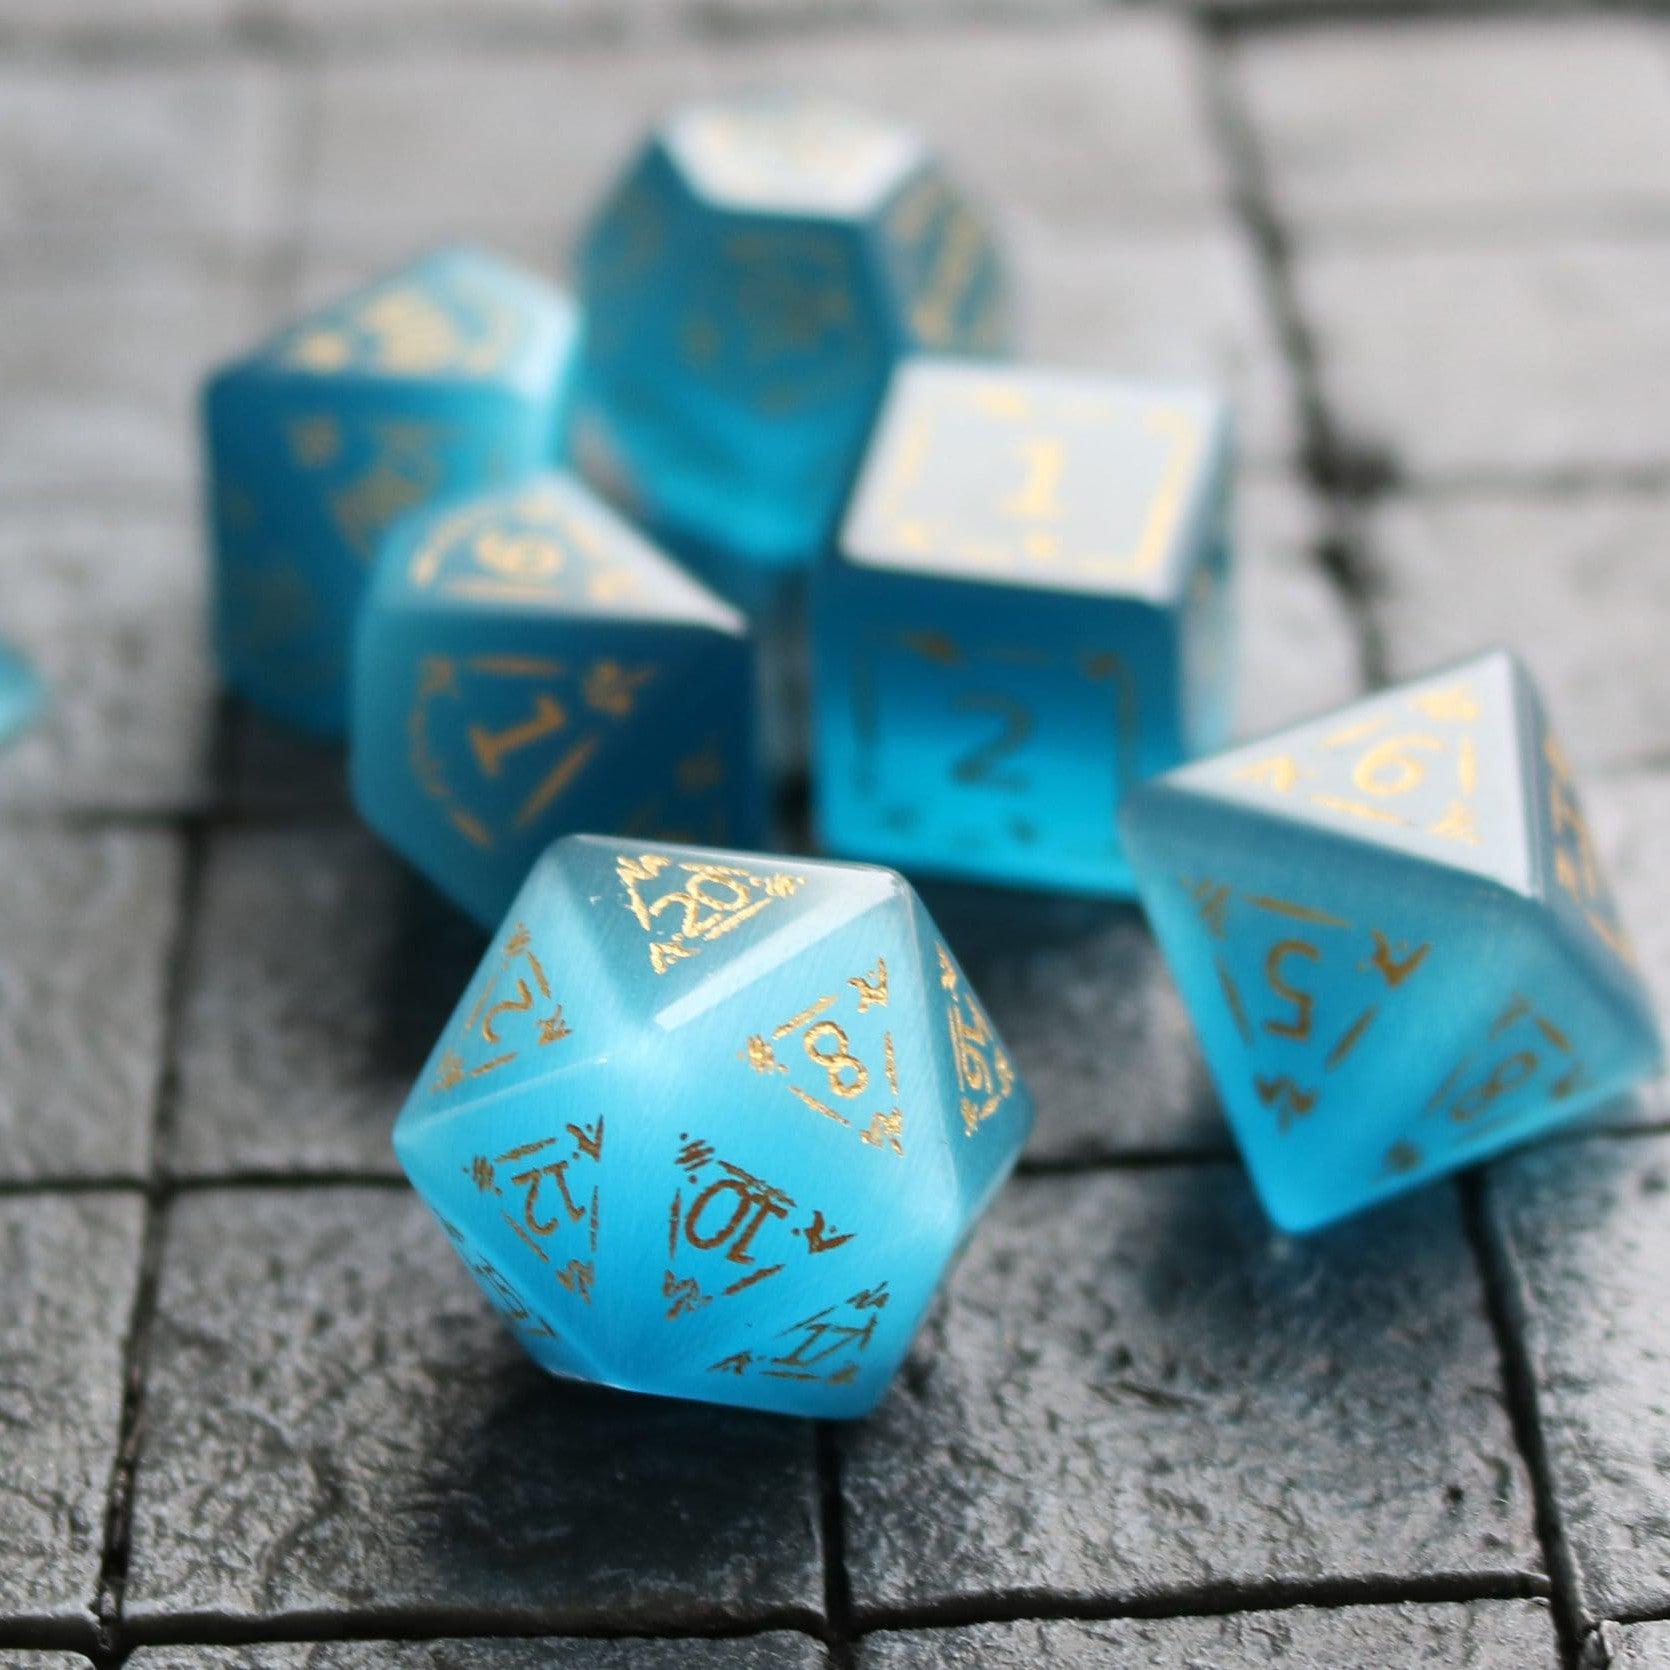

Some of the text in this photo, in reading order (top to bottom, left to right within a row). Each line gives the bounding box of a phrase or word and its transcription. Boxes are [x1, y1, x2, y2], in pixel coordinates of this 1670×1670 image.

[1003, 436, 1066, 520] 1
[468, 694, 566, 776] 1
[950, 692, 1035, 794] 2
[1352, 734, 1447, 796] 6
[649, 872, 752, 939] 20
[482, 977, 533, 1044] 2
[1264, 938, 1322, 1042] 5
[803, 1020, 869, 1098] 8
[1451, 1050, 1540, 1124] 8
[511, 1160, 586, 1237] 12
[685, 1179, 788, 1265] 10
